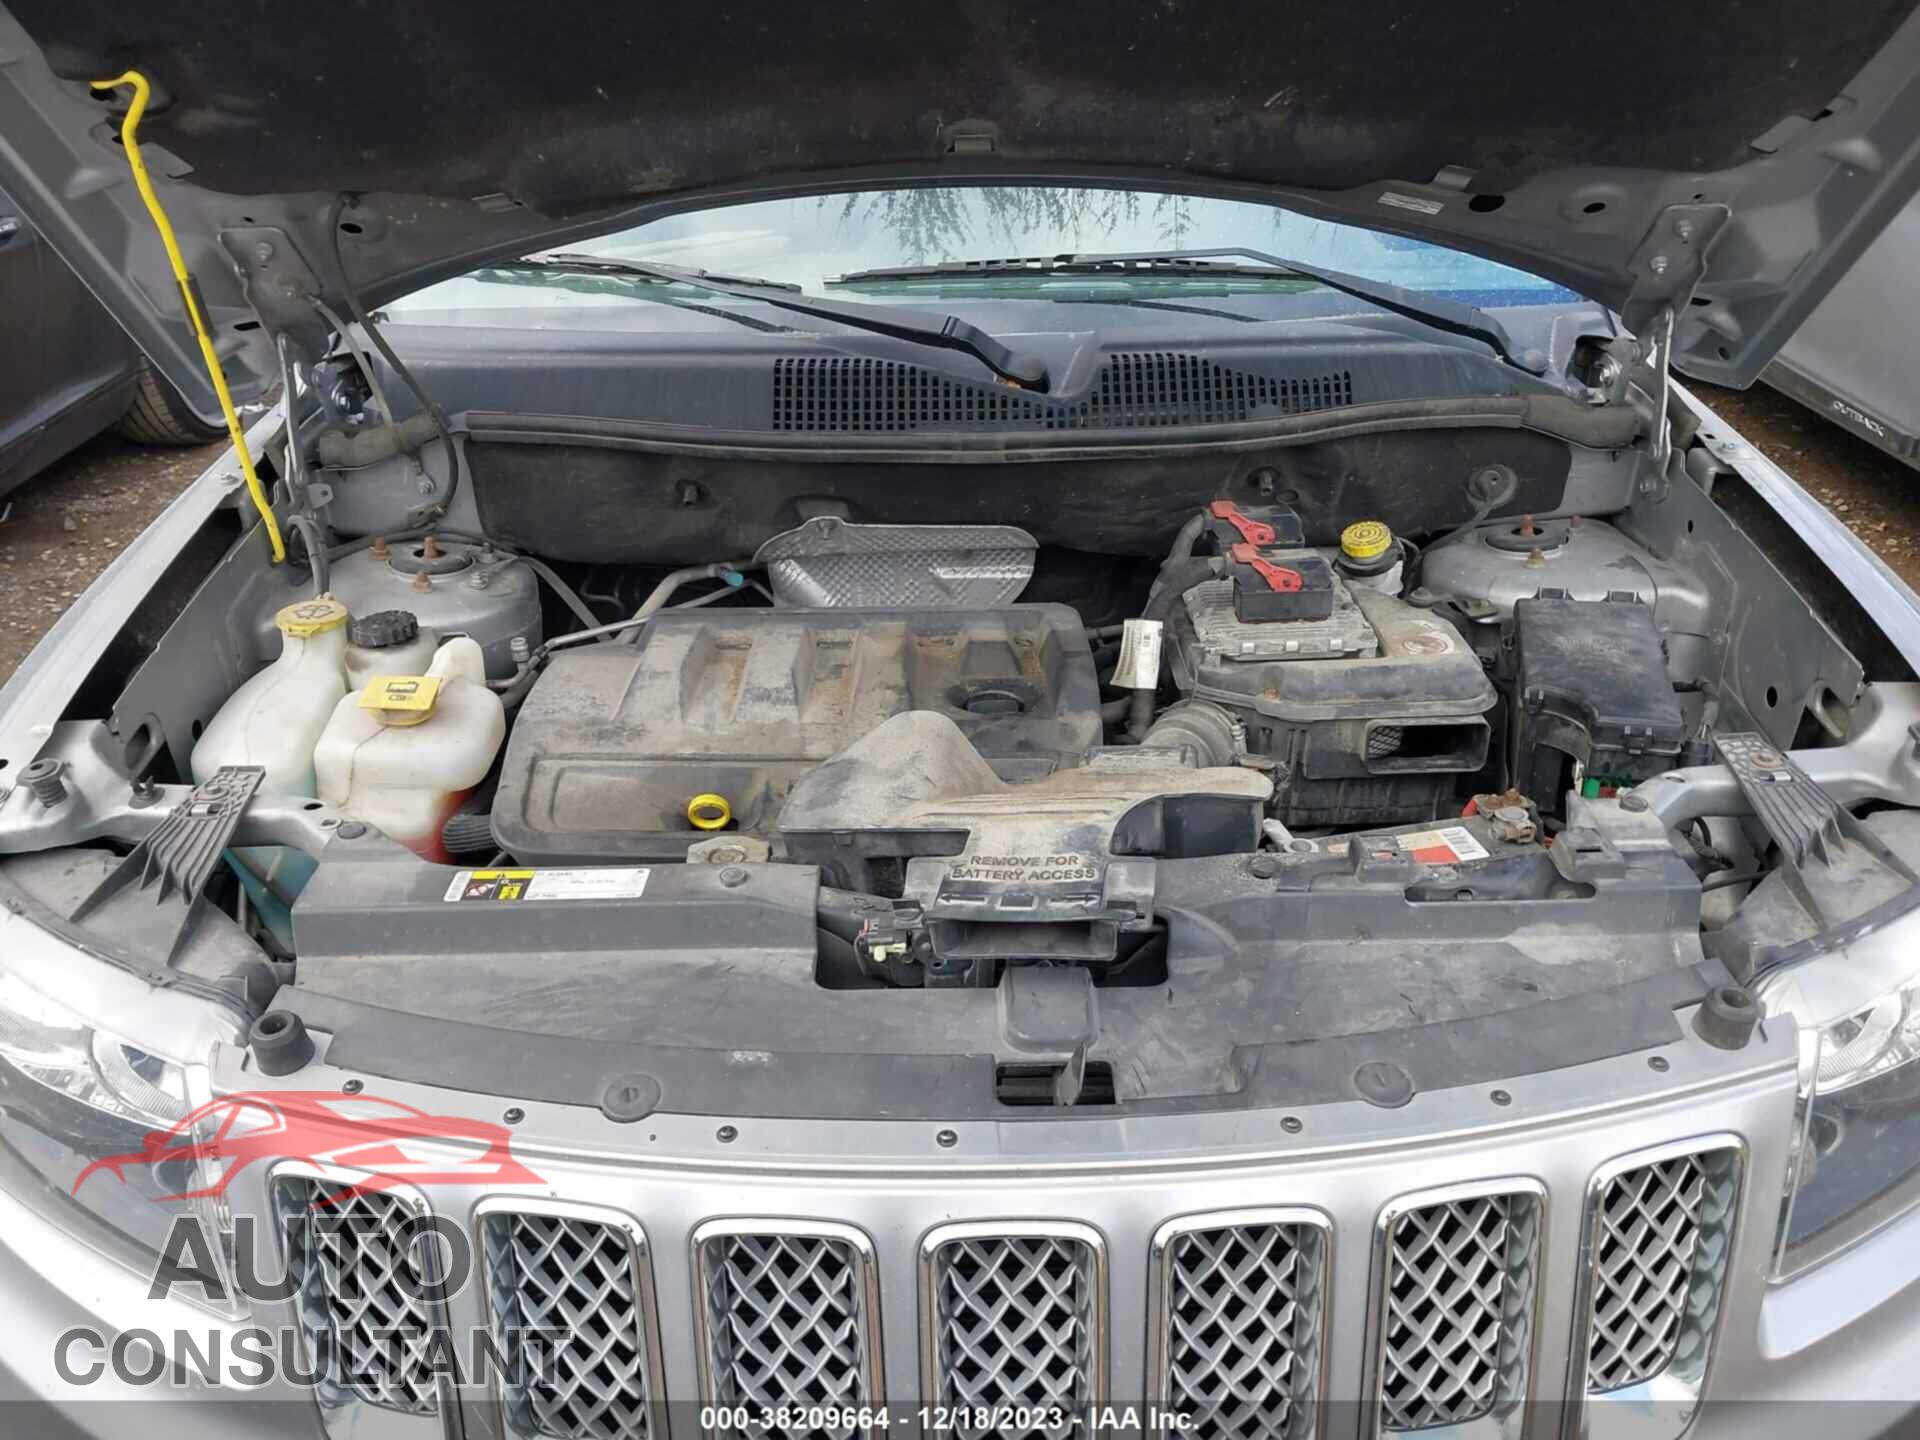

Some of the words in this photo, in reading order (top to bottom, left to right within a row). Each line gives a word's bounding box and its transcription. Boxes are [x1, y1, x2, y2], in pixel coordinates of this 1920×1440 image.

[970, 855, 1040, 867] REMOVE
[1045, 855, 1079, 866] FOR
[952, 868, 1025, 880] BATTERY
[1029, 867, 1096, 880] ACCESS
